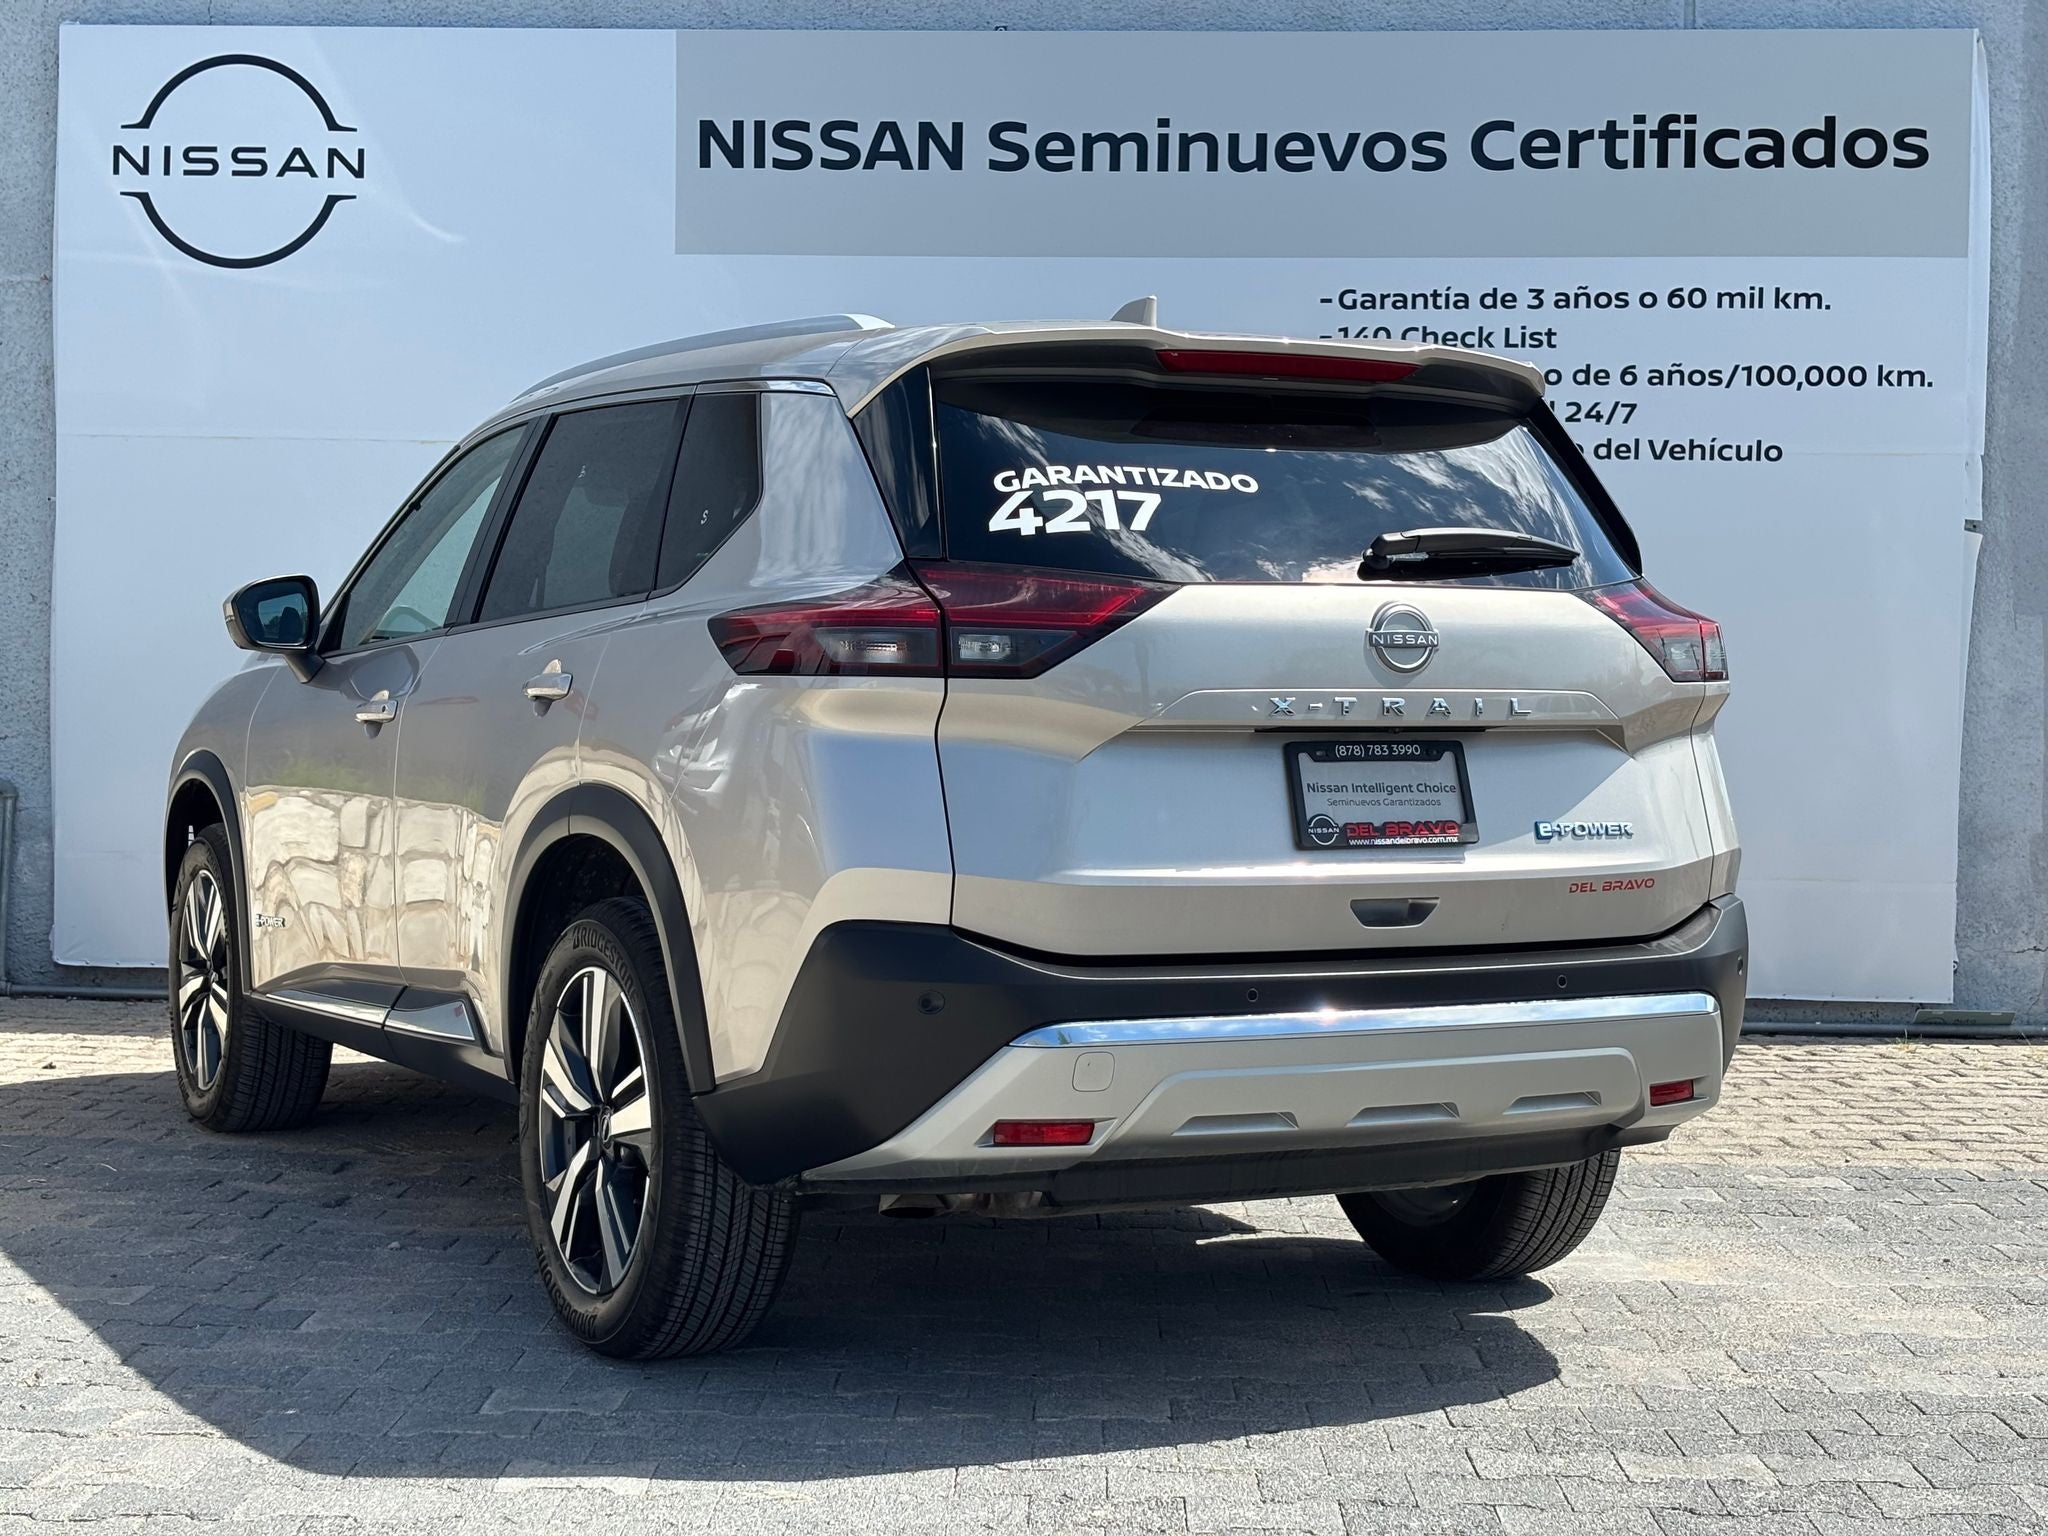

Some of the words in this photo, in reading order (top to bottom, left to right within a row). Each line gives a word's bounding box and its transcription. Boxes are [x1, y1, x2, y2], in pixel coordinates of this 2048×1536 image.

[700, 119, 964, 171] NISSAN
[987, 117, 1448, 173] Seminuevos
[1470, 114, 1930, 171] Certificados
[112, 144, 365, 179] NISSAN
[1479, 287, 1518, 310] de
[1526, 288, 1545, 310] 3
[1553, 286, 1630, 310] años
[1638, 291, 1658, 309] o
[1667, 287, 1707, 309] 60
[1716, 286, 1764, 309] mil
[1774, 286, 1832, 310] km.
[1401, 326, 1495, 348] Check
[1503, 326, 1558, 349] List
[1572, 364, 1611, 386] de
[1619, 365, 1638, 386] 6
[1647, 363, 1868, 391] años/100,000
[1877, 364, 1934, 387] km.
[1564, 401, 1638, 426] 24/7
[1593, 438, 1640, 460] del
[1648, 437, 1784, 462] Vehículo
[993, 465, 1259, 494] GARANTIZADO
[988, 489, 1162, 536] 4217
[1372, 634, 1438, 646] NISSAN
[1269, 696, 1532, 717] X-TRAIL
[1335, 744, 1365, 758] (878)
[1367, 744, 1389, 756] 783
[1391, 744, 1421, 756] 3990
[1306, 782, 1349, 794] Nissan
[1351, 782, 1414, 796] Intelligent
[1416, 781, 1457, 794] Choice
[1326, 797, 1381, 807] Seminuevos
[1382, 797, 1442, 807] Garantizados
[1307, 826, 1340, 834] NISSAN
[1346, 825, 1380, 836] DEL
[1385, 823, 1460, 836] BRAVO
[1535, 820, 1634, 840] e-POWER
[1568, 882, 1598, 894] DEL
[1601, 877, 1656, 893] BRAVO
